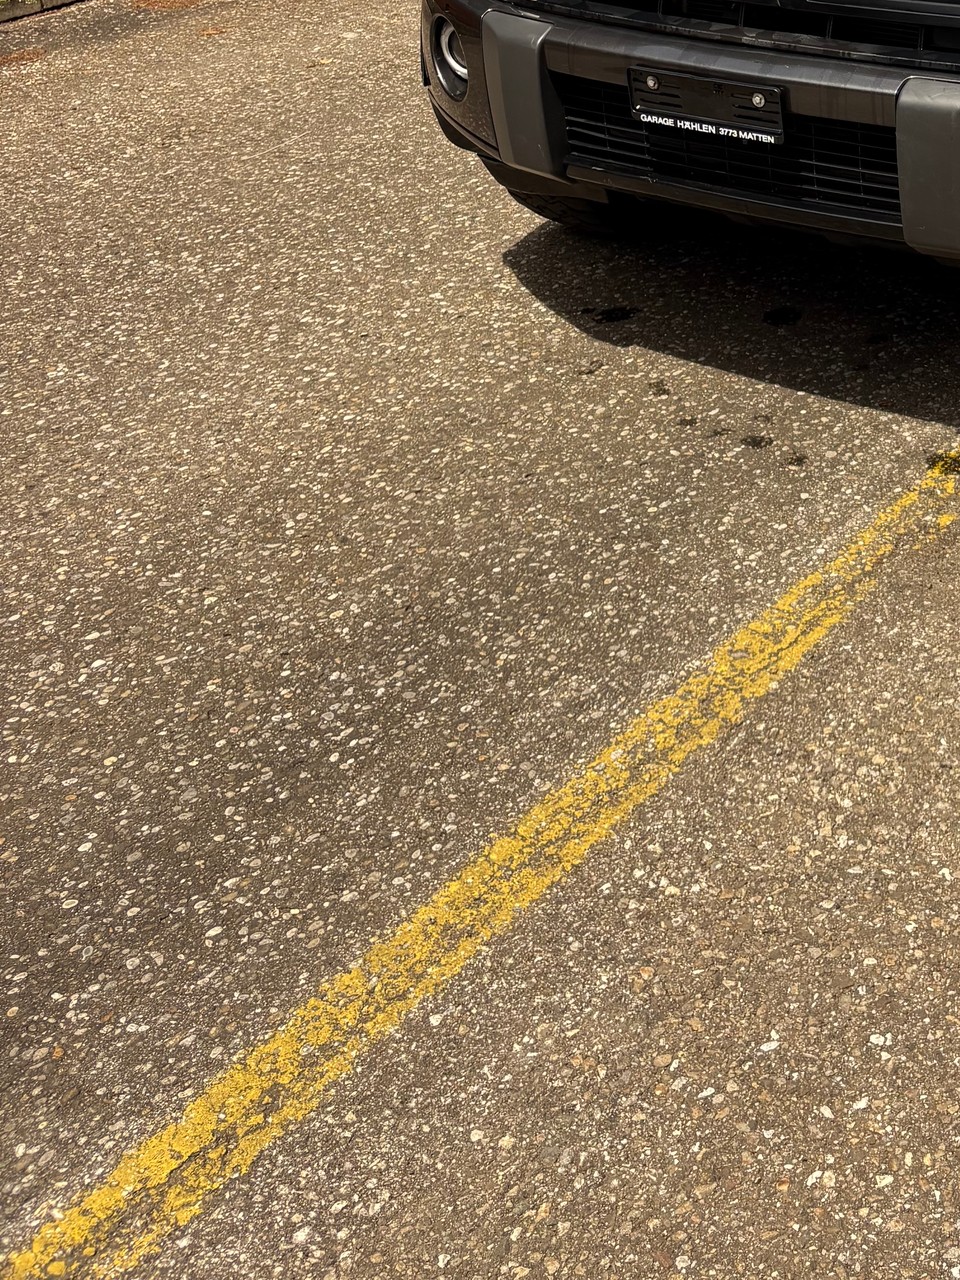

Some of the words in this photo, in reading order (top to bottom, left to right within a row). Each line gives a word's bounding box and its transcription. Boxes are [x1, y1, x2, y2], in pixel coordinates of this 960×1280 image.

[640, 113, 675, 127] GARAGE
[677, 119, 716, 134] HÄHLEN
[718, 127, 738, 138] 3773
[739, 130, 775, 144] MATTEN
